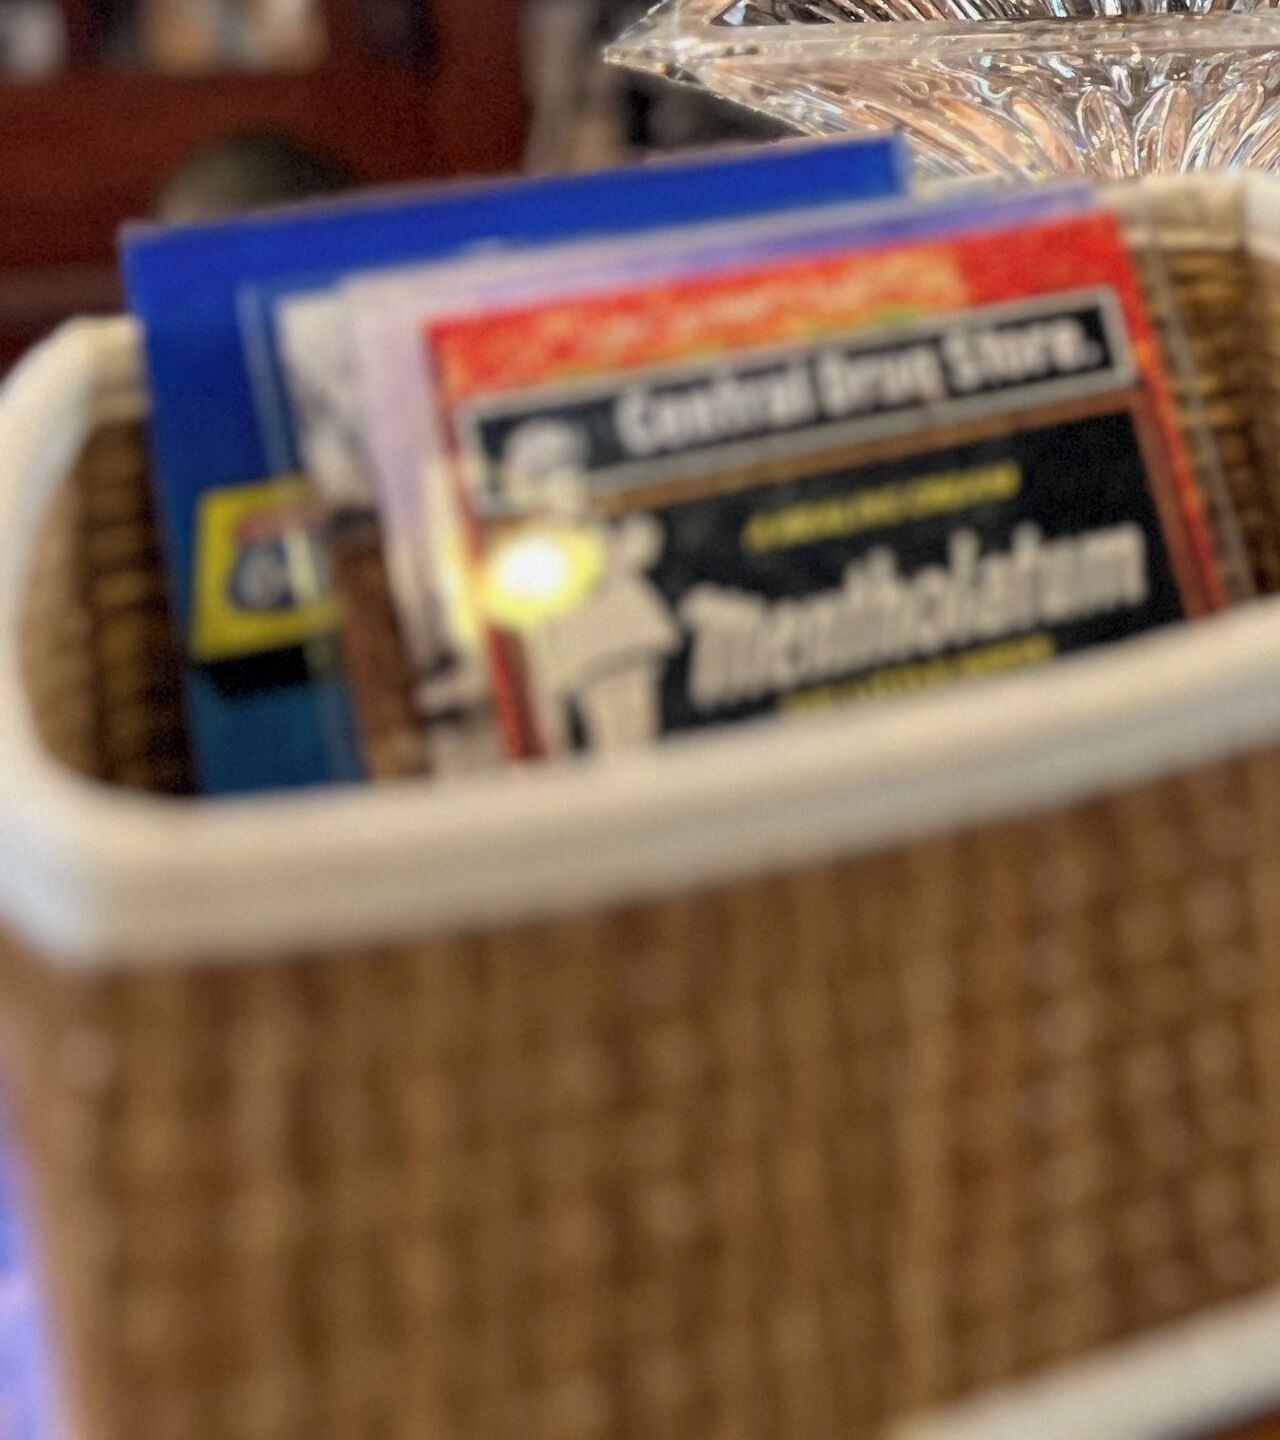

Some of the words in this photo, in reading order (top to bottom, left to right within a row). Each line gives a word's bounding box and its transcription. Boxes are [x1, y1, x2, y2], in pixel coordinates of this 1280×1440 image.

[612, 357, 810, 458] Central
[818, 334, 943, 420] Drug
[677, 520, 1150, 712] Mentholatum
